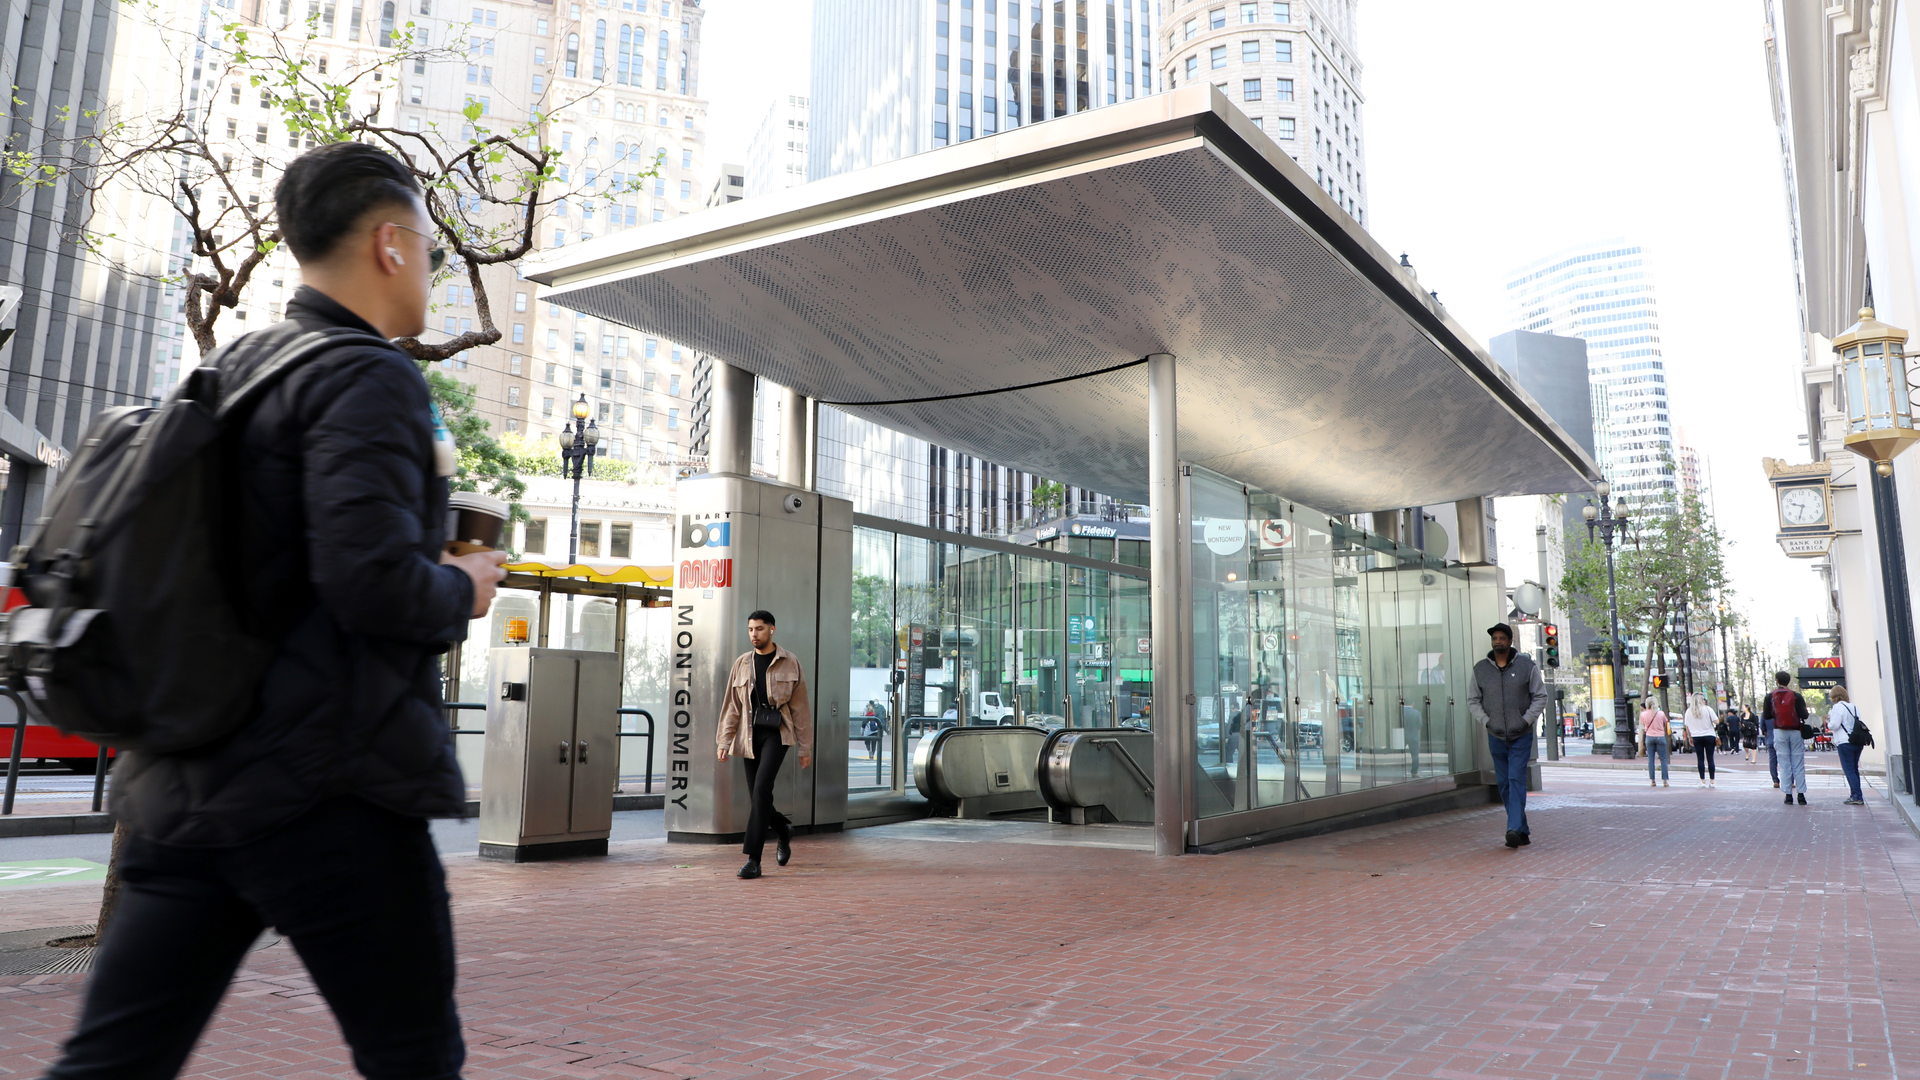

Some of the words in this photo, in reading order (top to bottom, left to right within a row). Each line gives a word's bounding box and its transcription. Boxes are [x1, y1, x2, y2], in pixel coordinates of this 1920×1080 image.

[695, 512, 731, 520] BART
[1082, 525, 1117, 537] Fidelity
[671, 605, 694, 811] MONTGOMERY
